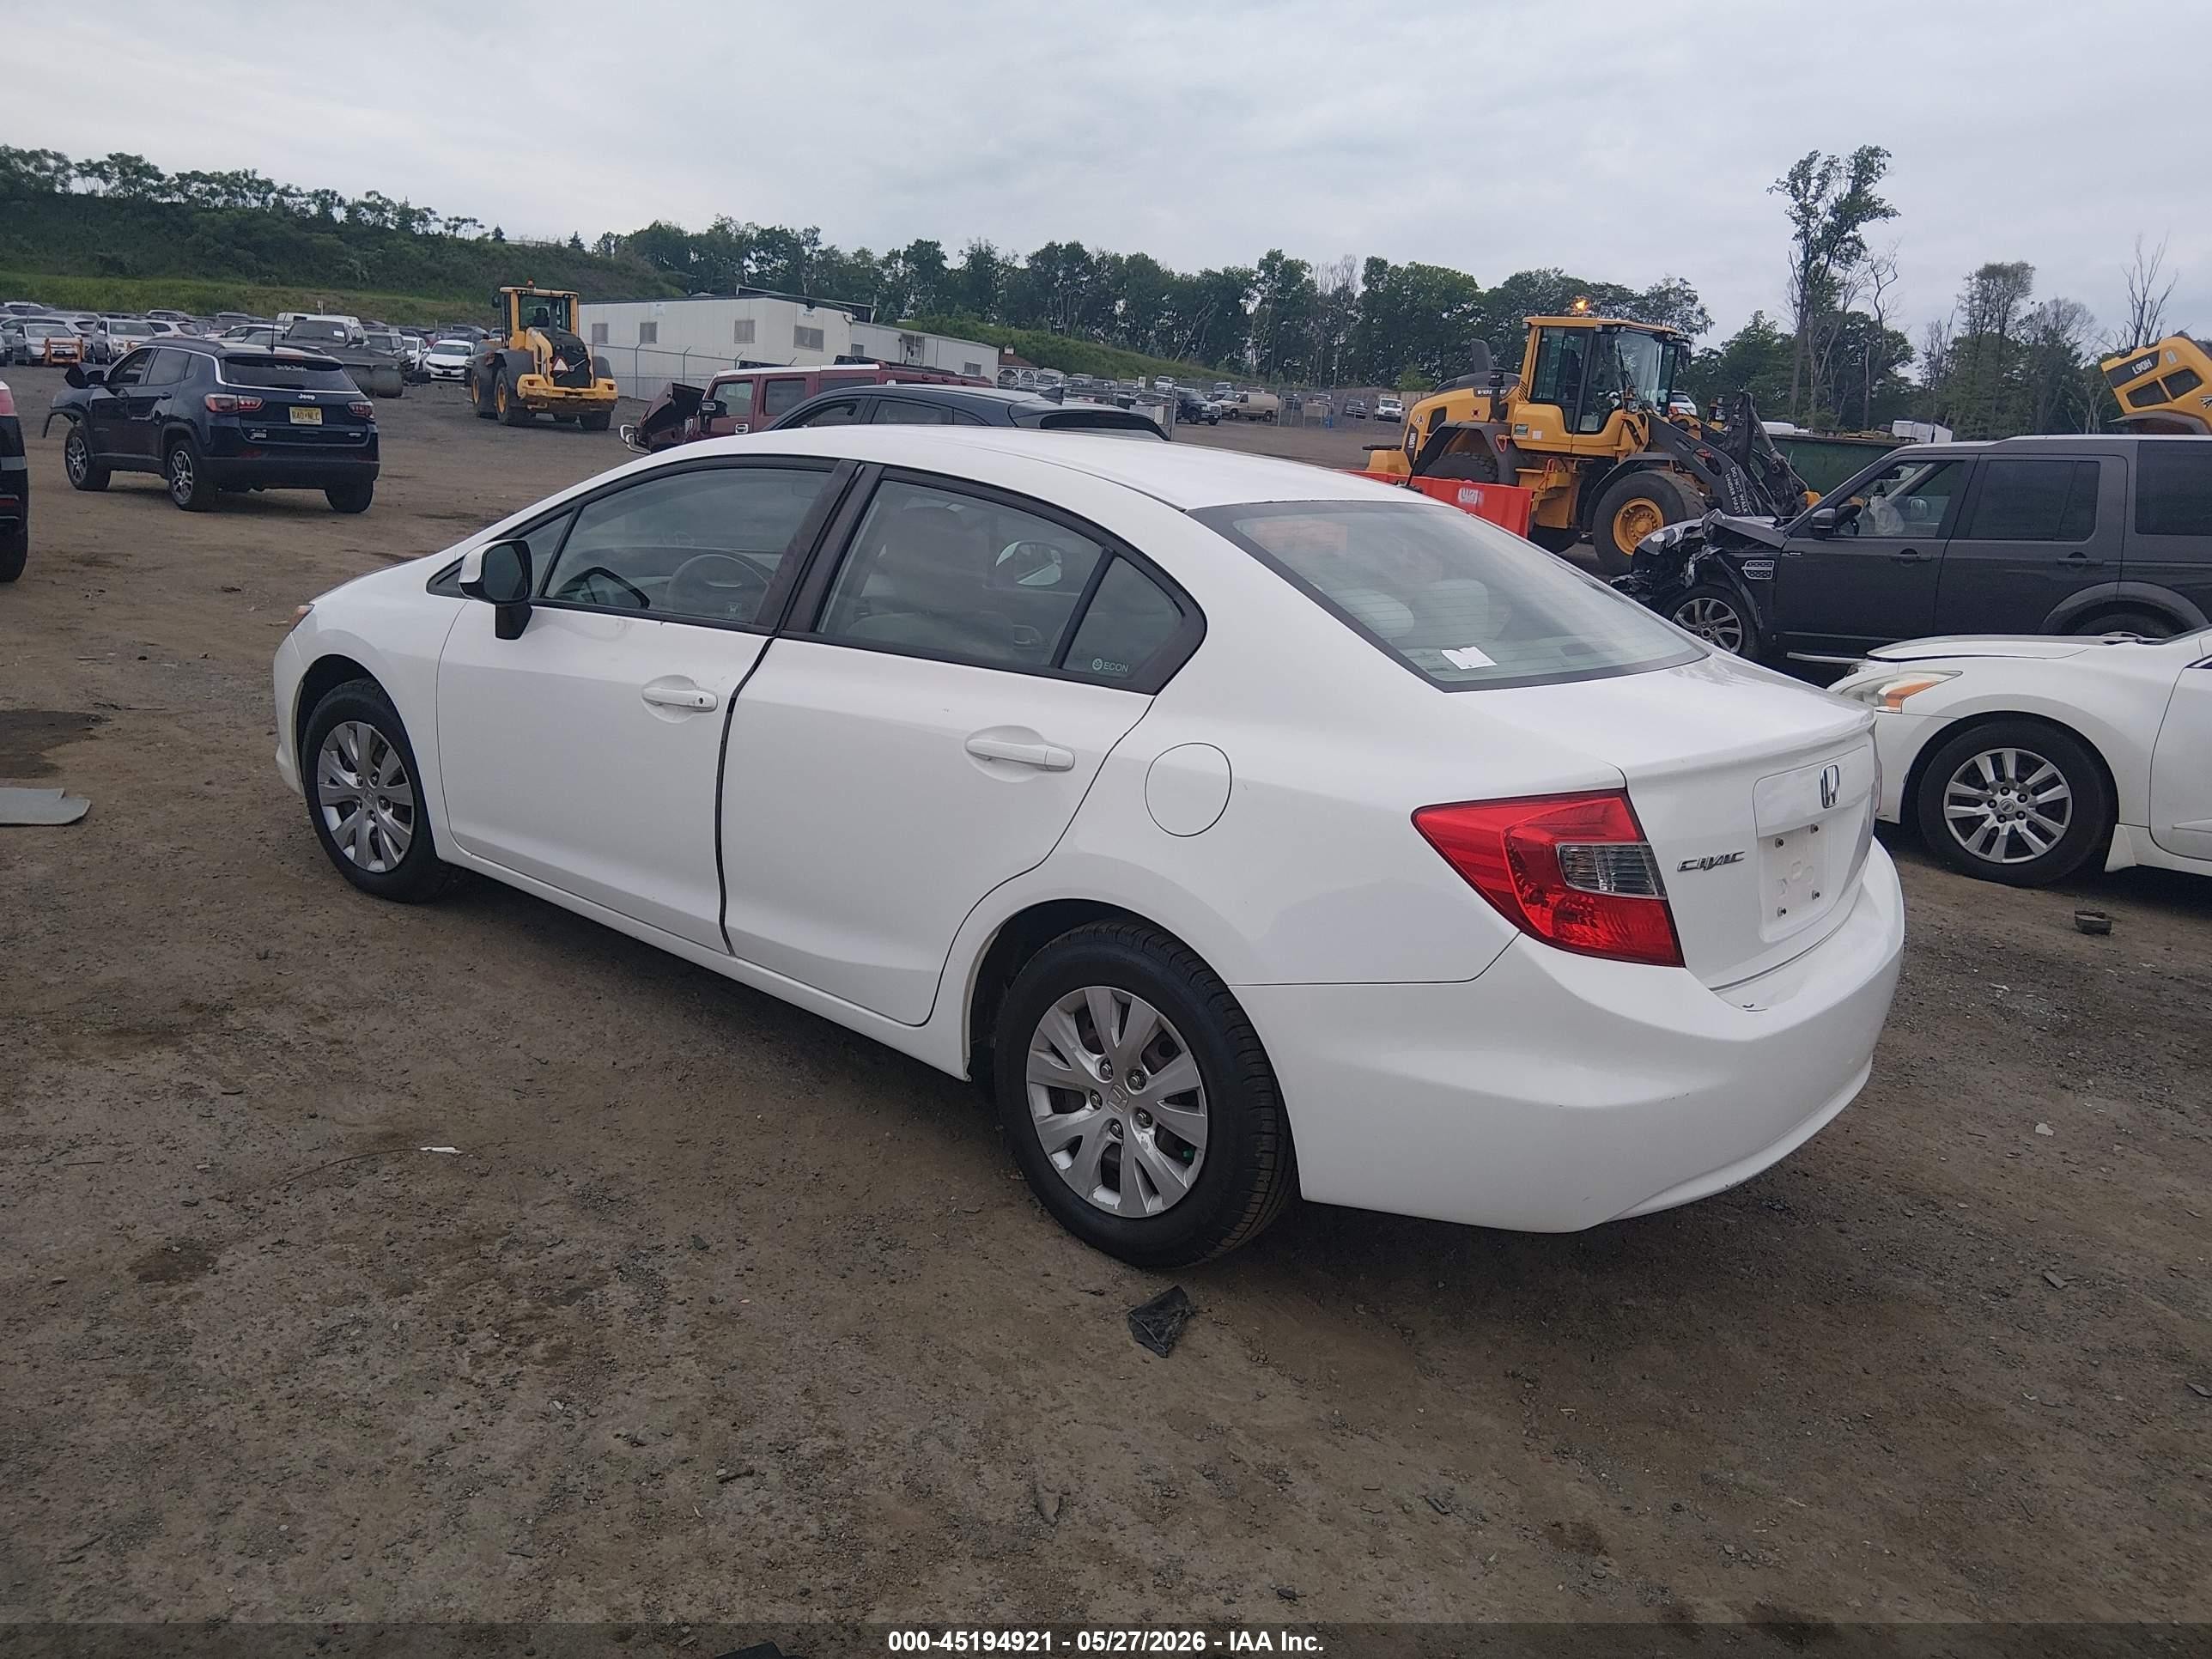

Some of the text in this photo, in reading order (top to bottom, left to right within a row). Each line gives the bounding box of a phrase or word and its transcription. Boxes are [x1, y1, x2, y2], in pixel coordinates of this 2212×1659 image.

[2131, 358, 2153, 374] L90H
[1408, 432, 1417, 449] L90H
[1730, 466, 1738, 478] DO
[1724, 473, 1735, 496] UNDER
[1103, 661, 1129, 672] ECON
[1676, 850, 1746, 872] CIVIC
